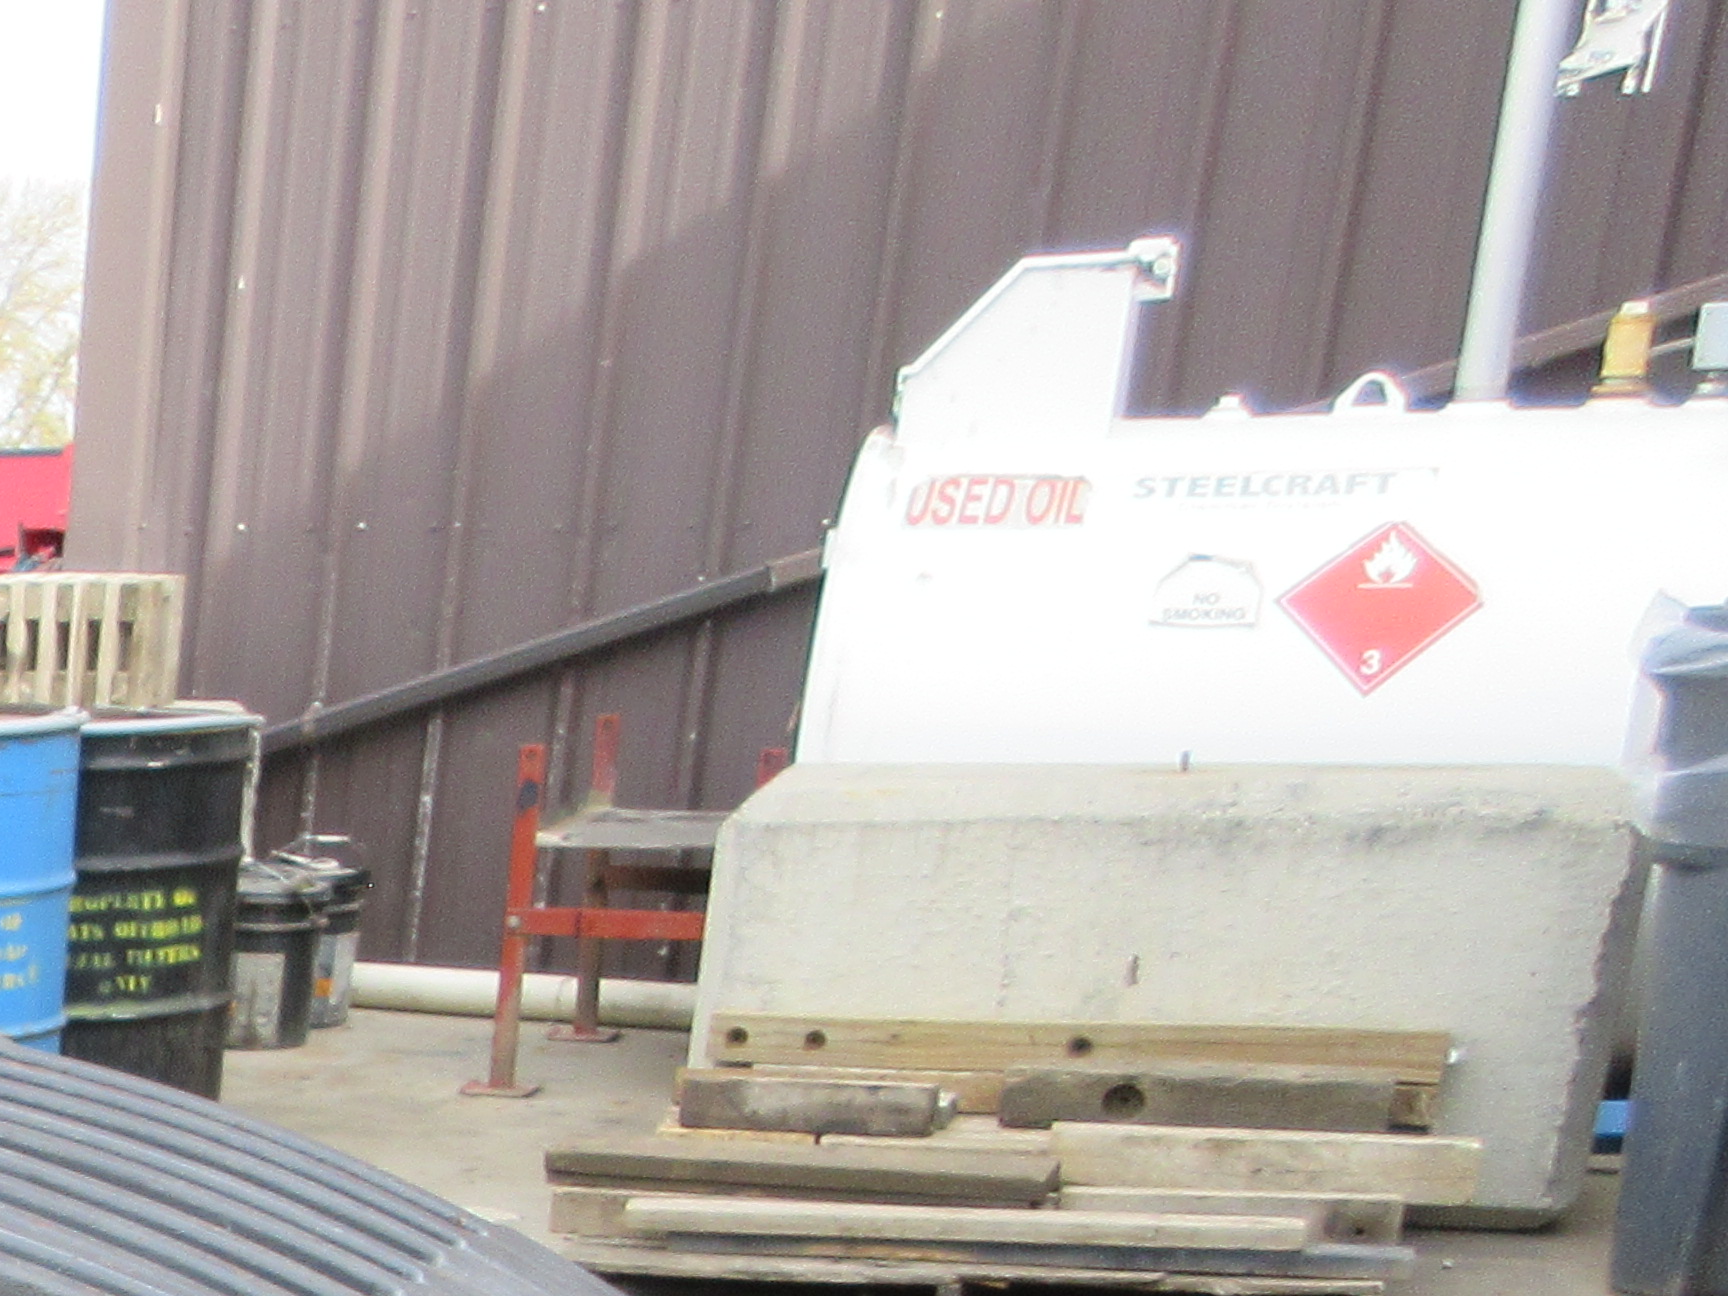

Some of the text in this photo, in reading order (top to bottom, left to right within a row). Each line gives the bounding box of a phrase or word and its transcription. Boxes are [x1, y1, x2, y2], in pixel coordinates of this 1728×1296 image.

[1132, 470, 1398, 499] STEELCRAFT
[904, 477, 1087, 526] USED OIL
[1191, 592, 1220, 606] NO
[1160, 607, 1247, 623] SMOKING
[1359, 648, 1381, 675] 3
[69, 890, 165, 912] ROPERTY
